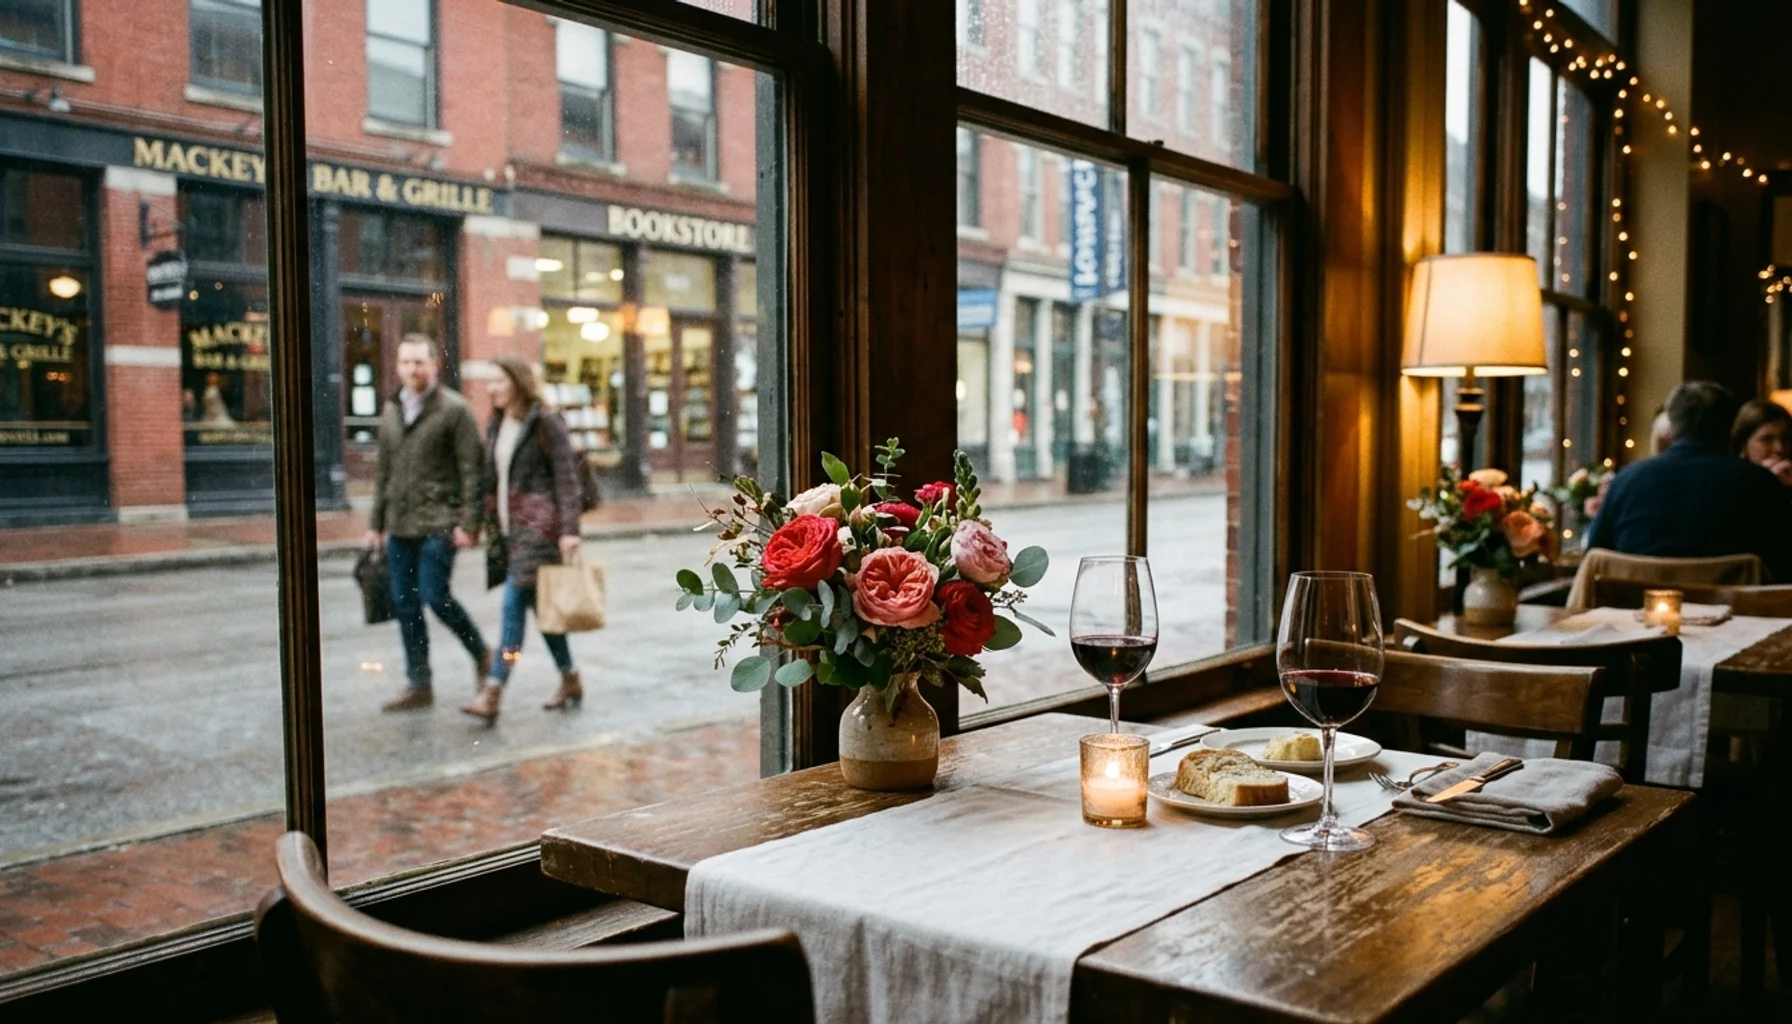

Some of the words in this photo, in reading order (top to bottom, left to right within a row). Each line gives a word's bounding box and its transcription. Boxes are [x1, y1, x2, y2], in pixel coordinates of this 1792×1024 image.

[313, 163, 372, 199] BAR
[376, 173, 398, 203] &
[403, 177, 494, 215] GRILLE
[608, 204, 754, 253] BOOKSTORE
